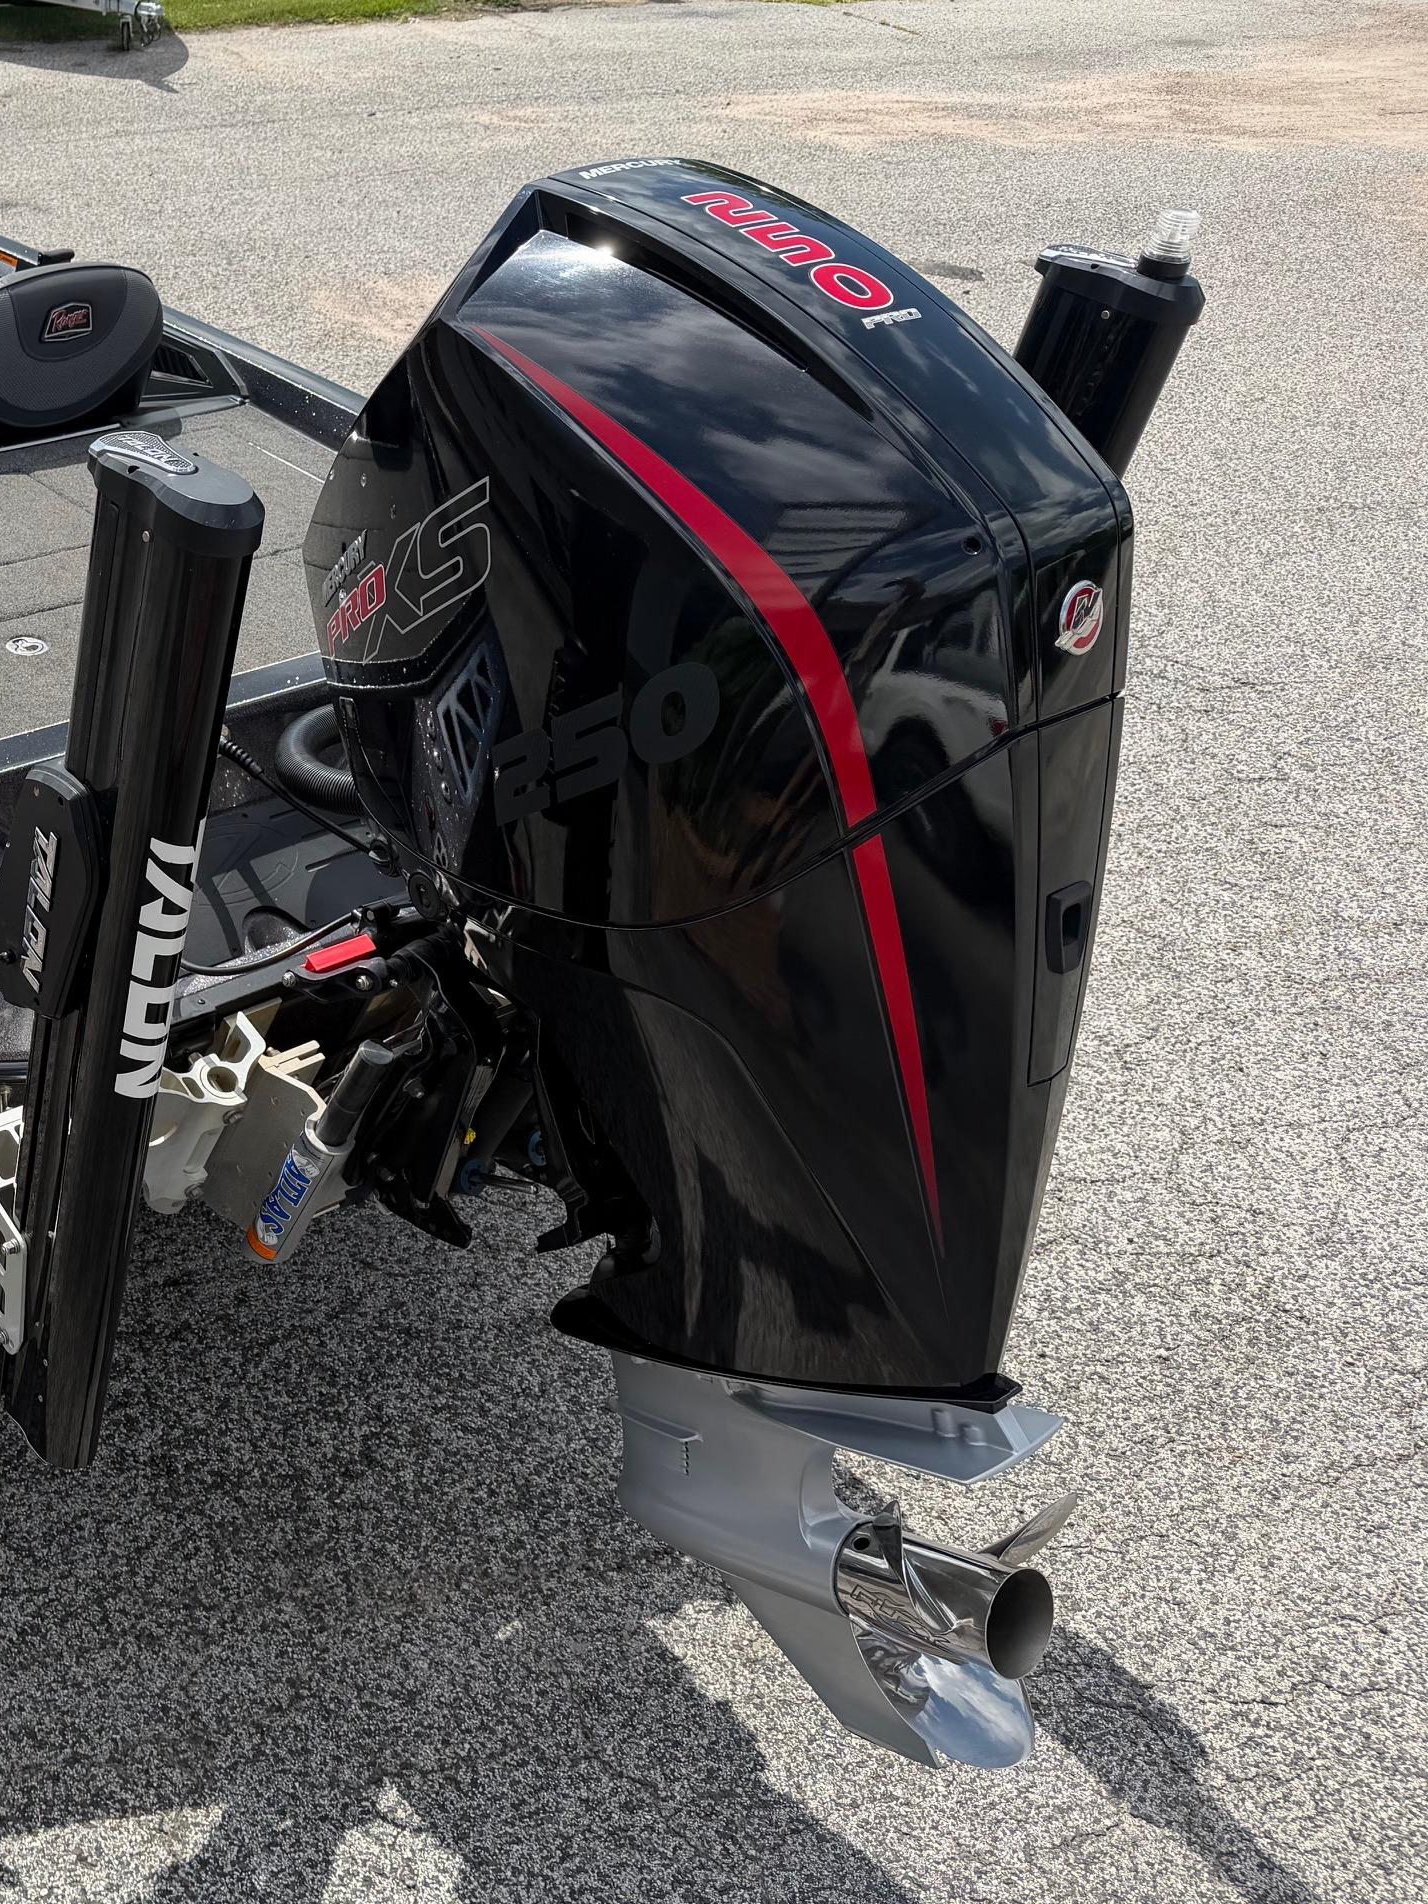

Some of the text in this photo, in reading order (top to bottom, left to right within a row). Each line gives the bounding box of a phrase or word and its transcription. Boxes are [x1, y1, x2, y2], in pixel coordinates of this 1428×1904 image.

[578, 159, 682, 180] MERCURY
[680, 191, 895, 311] 250
[861, 307, 923, 330] PRO
[326, 475, 492, 666] PRO XS
[491, 661, 721, 828] 250
[21, 825, 59, 994] TALON
[114, 817, 208, 1099] TALON
[259, 1150, 313, 1237] ATLAS
